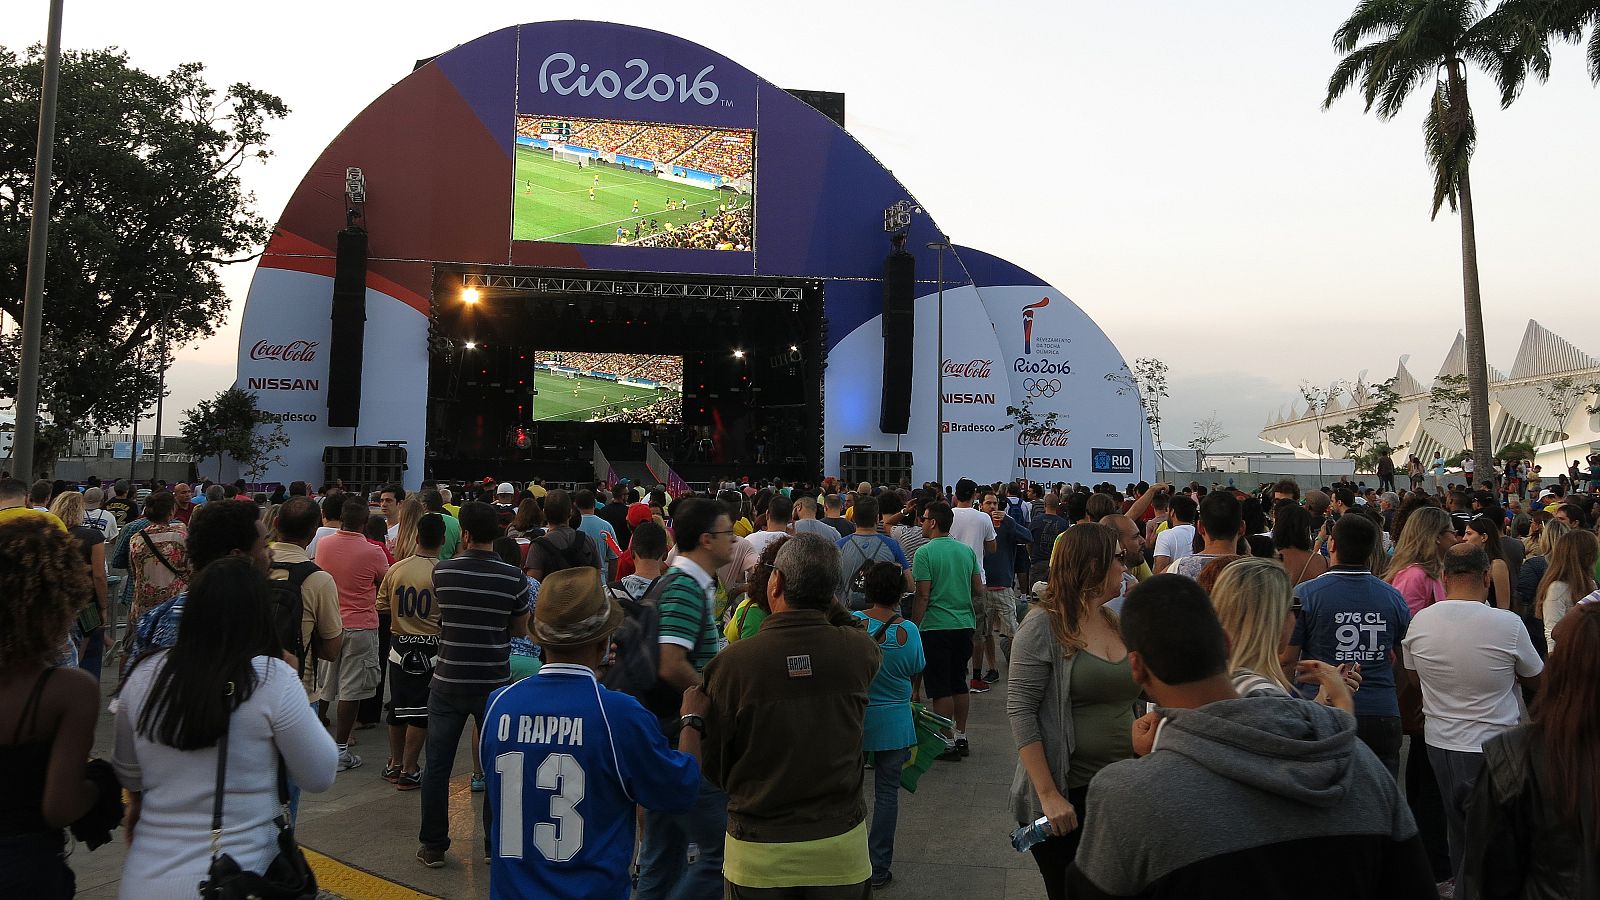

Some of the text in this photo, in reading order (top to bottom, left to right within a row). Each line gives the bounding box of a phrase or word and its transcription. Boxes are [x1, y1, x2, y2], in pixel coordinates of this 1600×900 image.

[250, 340, 320, 361] Coca-Cola
[248, 378, 319, 391] NISSAN
[951, 423, 996, 432] Bradesco
[1018, 457, 1072, 468] NISSAN
[1111, 455, 1131, 466] RIO
[396, 585, 431, 619] 100
[1334, 612, 1387, 624] 976 CL
[1335, 624, 1387, 652] 9.T.
[1335, 651, 1384, 661] SERIE 2
[498, 713, 583, 746] O RAPPA
[495, 751, 585, 862] 13
